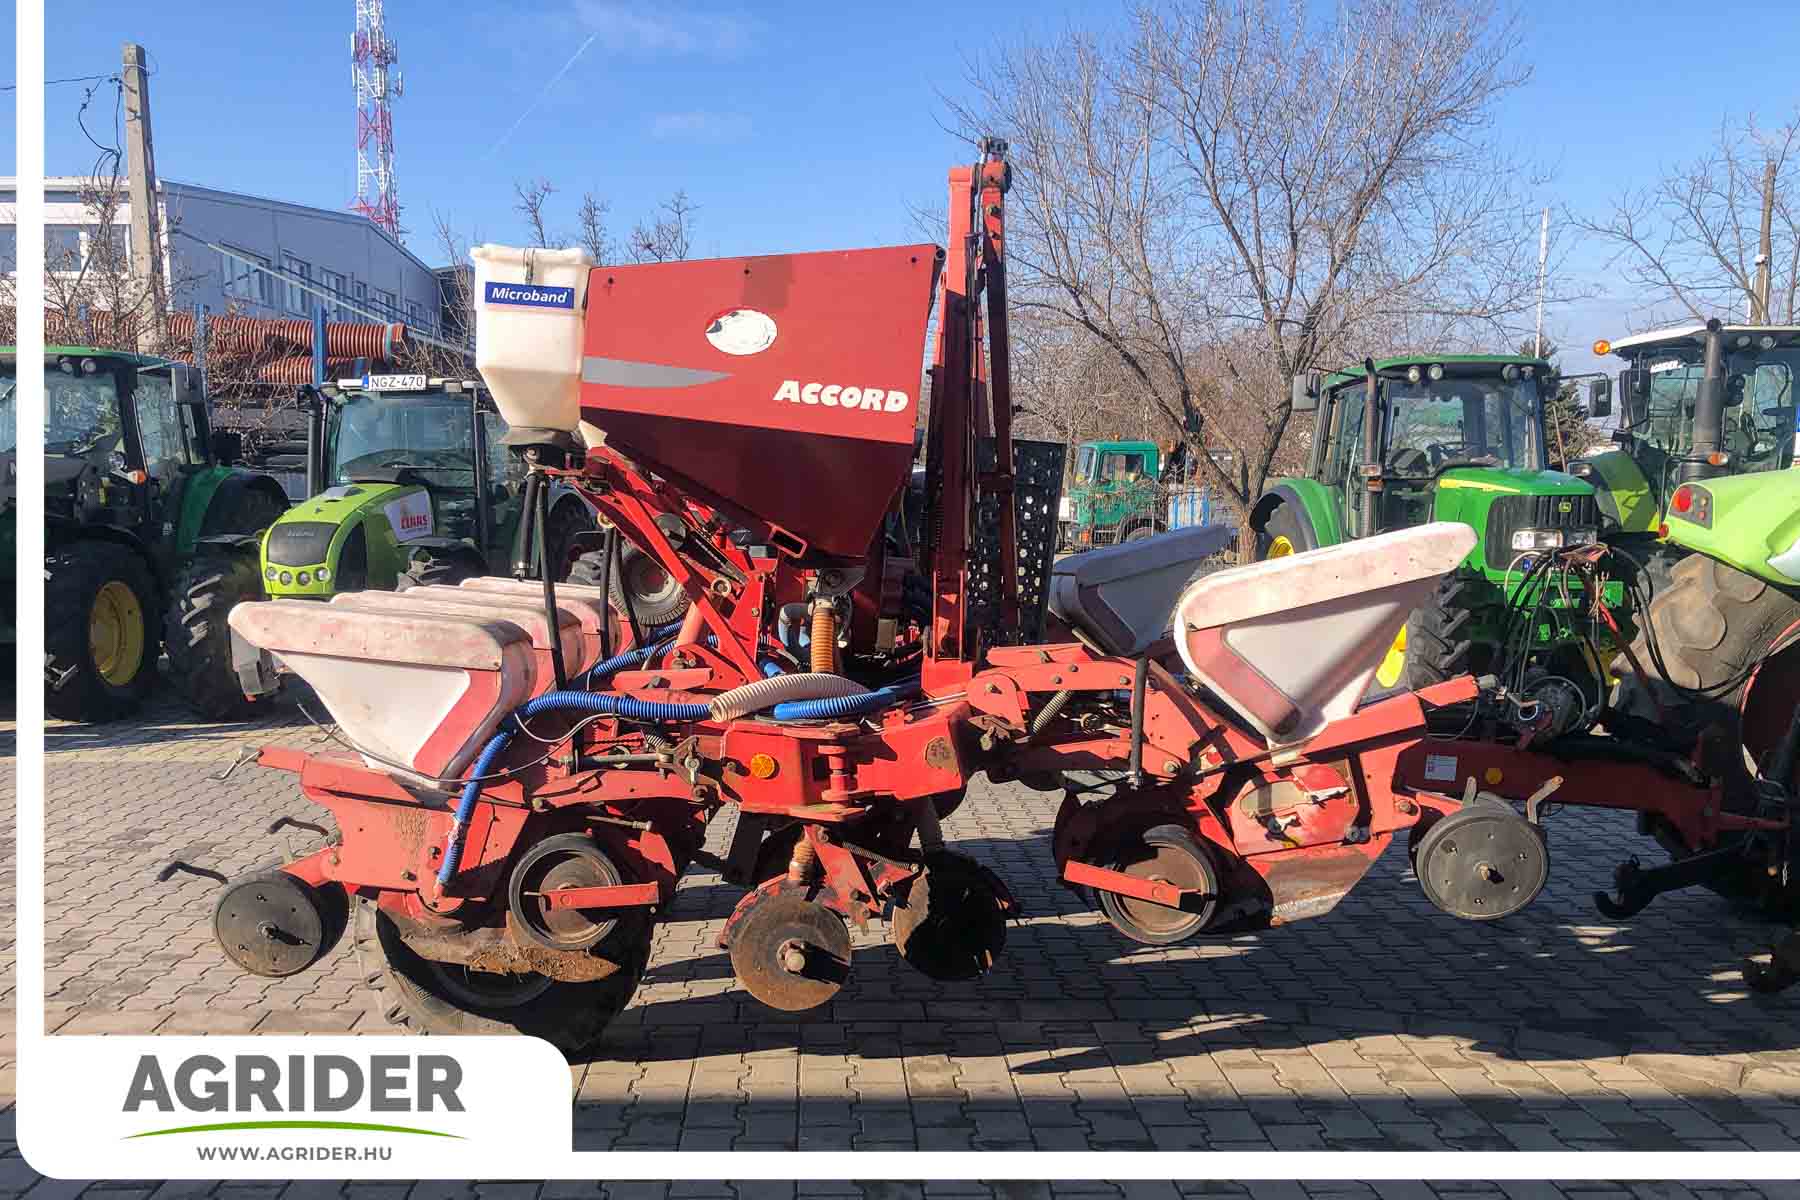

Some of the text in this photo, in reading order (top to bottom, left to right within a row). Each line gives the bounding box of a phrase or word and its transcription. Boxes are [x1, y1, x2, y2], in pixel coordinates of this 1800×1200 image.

[491, 287, 568, 303] Microband
[371, 376, 423, 388] NGZ-470
[772, 379, 909, 412] ACCORD
